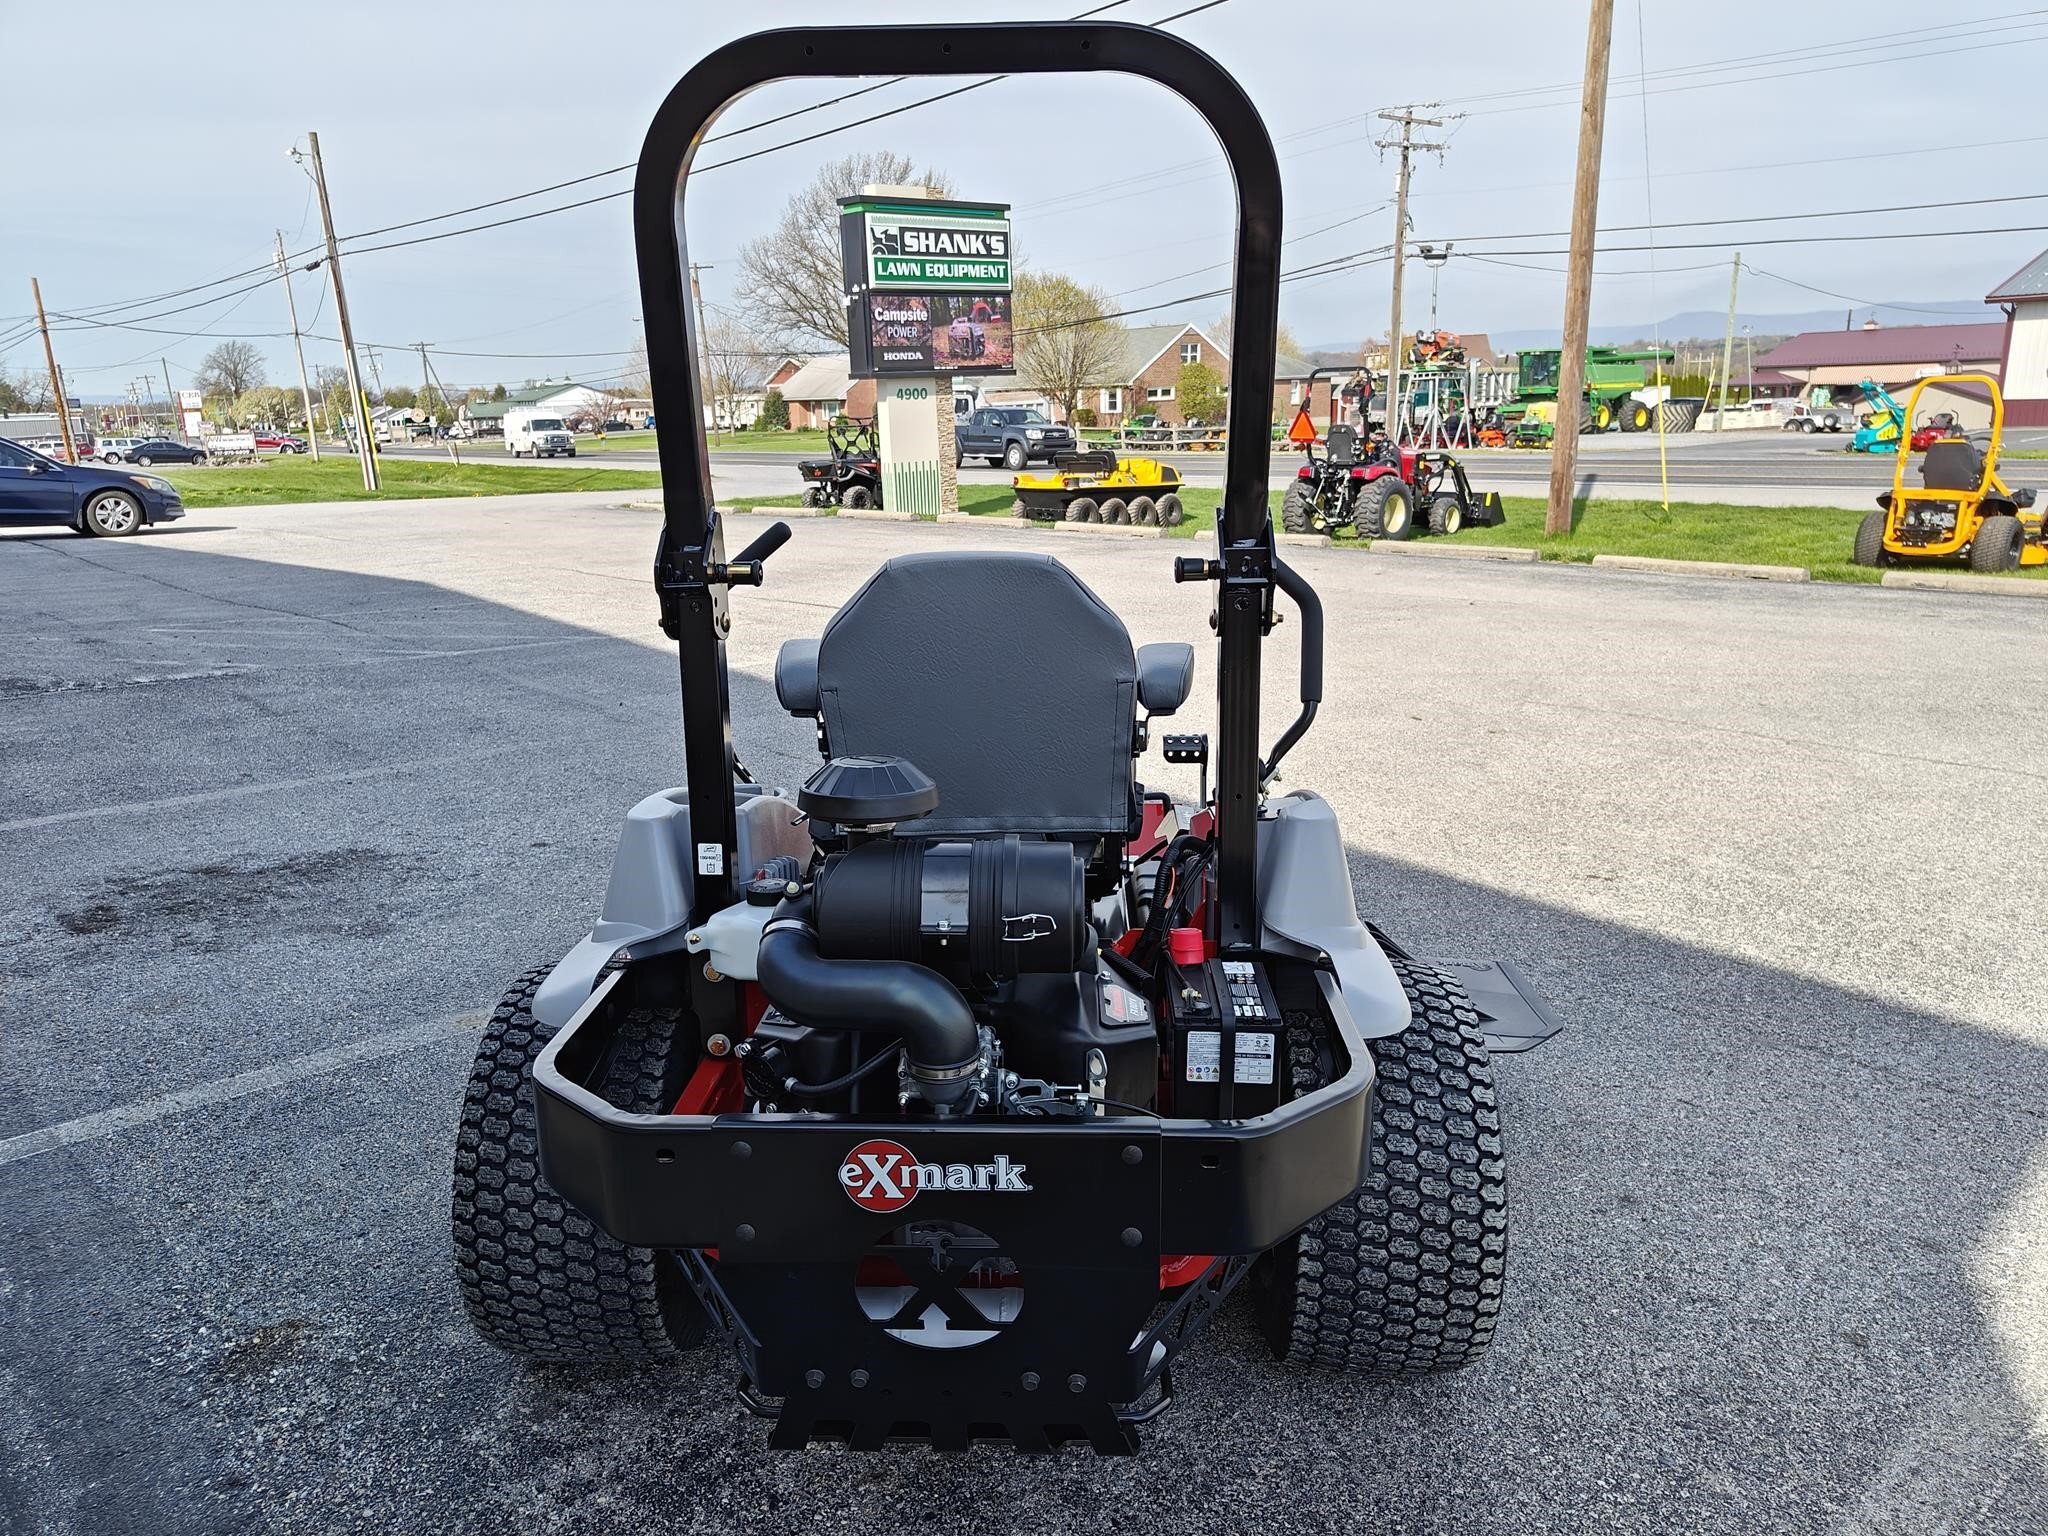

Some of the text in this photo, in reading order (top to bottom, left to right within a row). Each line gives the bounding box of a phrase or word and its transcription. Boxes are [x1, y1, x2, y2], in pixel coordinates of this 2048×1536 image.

[904, 231, 1005, 255] SHANK'S
[877, 262, 1006, 279] LAWN EQUIPMENT
[874, 307, 928, 324] Campsite
[887, 326, 918, 338] POWER
[883, 352, 923, 361] HONDA
[896, 387, 928, 400] 4900
